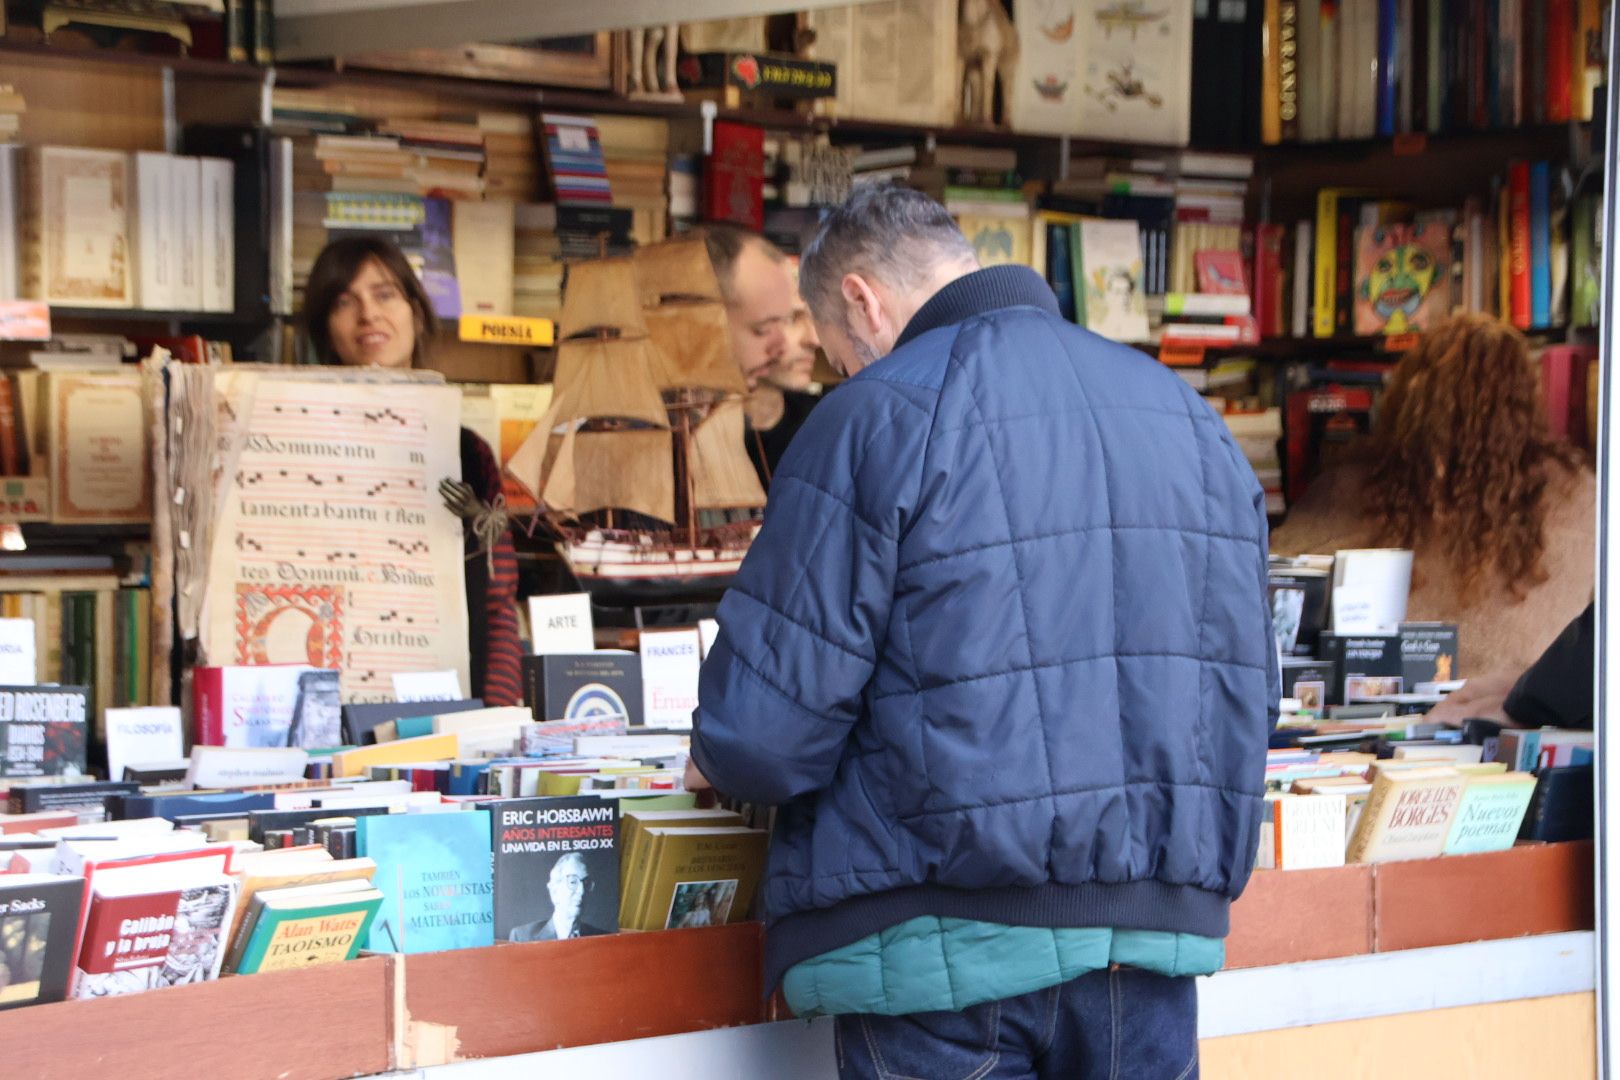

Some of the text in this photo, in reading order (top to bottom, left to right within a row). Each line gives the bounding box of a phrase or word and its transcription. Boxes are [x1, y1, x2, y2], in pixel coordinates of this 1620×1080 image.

[549, 616, 577, 629] ARTE
[502, 807, 613, 826] ERIC HOBSBAWM
[1388, 803, 1449, 829] BORGES
[1463, 804, 1521, 822] Nuevos
[502, 825, 613, 841] AÑOS INTERESANTES
[1453, 822, 1512, 845] poemas
[502, 838, 613, 854] UNA VIDA EN EL SIGLO XX
[410, 911, 492, 928] MATEMÁTICAS
[280, 919, 357, 939] Alan Watts
